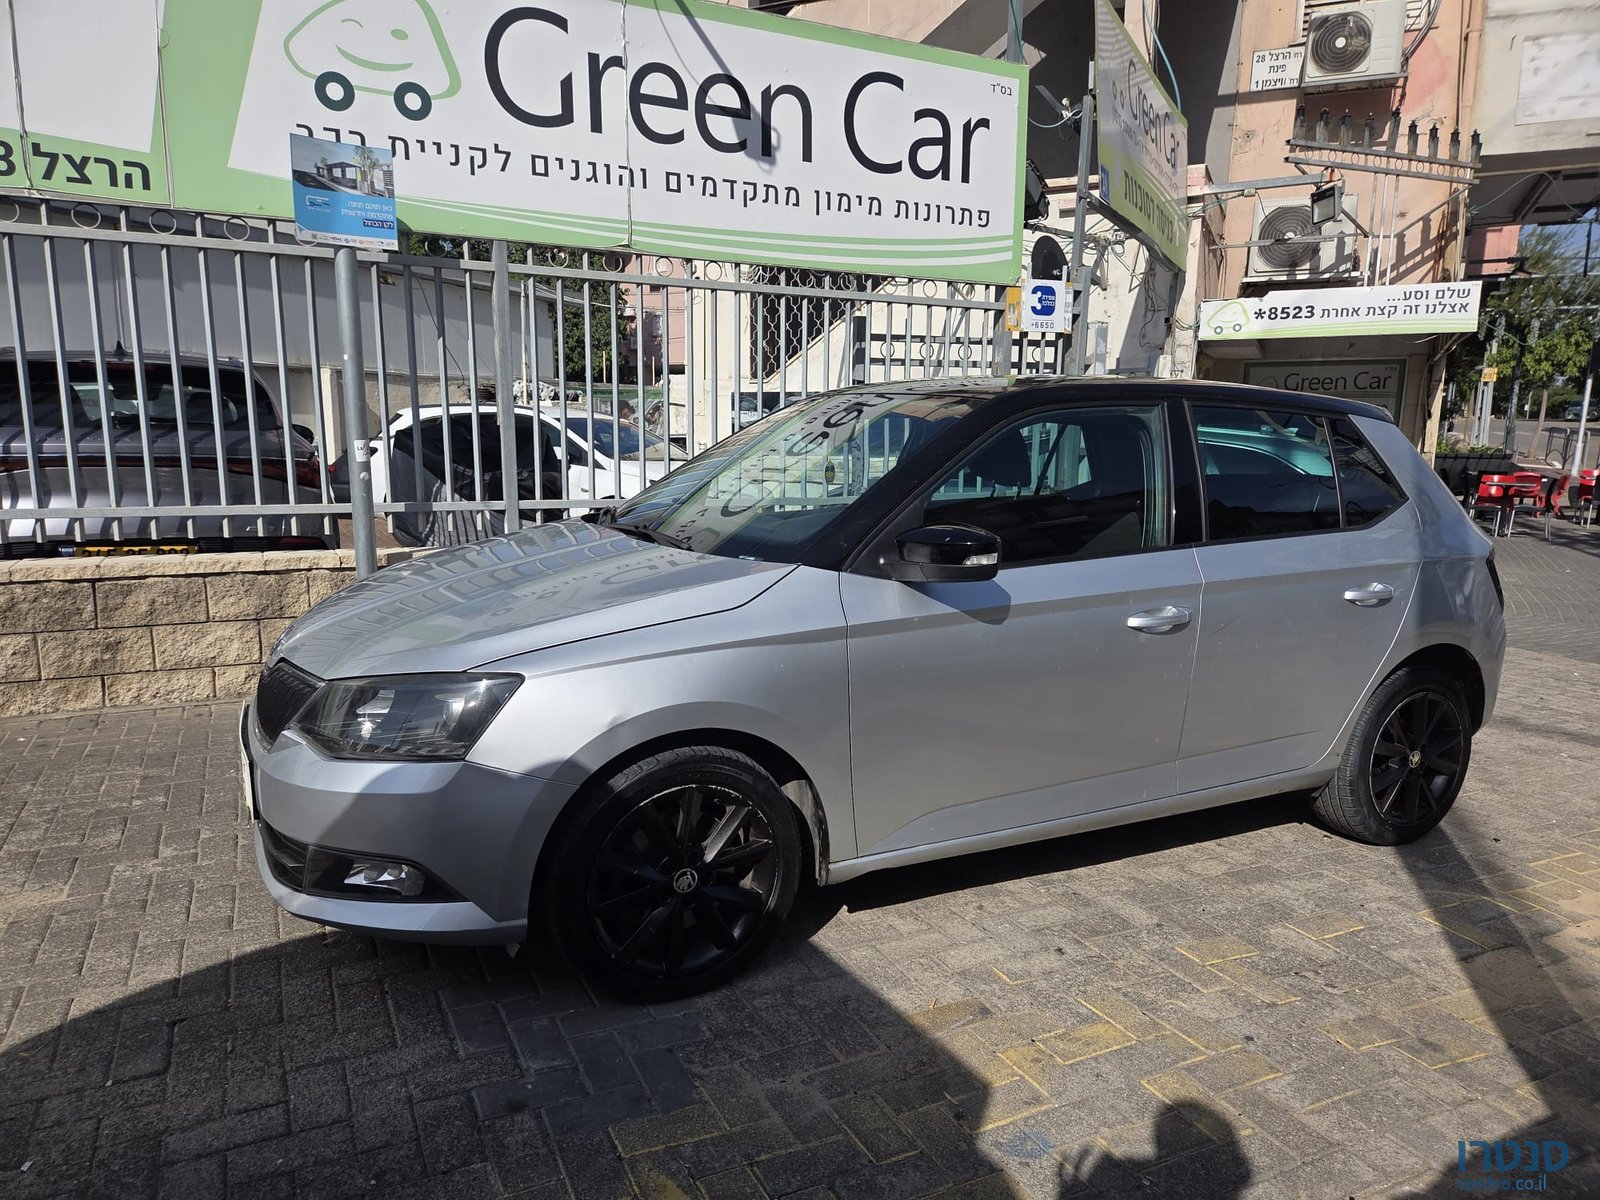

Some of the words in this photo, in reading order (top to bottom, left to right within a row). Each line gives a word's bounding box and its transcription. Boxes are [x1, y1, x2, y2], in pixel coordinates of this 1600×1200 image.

[1255, 54, 1267, 64] 28
[1268, 51, 1292, 62] הרצל
[1268, 64, 1287, 75] פינת
[1255, 80, 1260, 89] 1
[484, 6, 813, 163] Green
[843, 71, 991, 183] Car
[1127, 58, 1162, 154] Green
[1163, 111, 1180, 176] Car
[387, 134, 512, 176] לקניית
[31, 142, 151, 191] הרצל
[530, 154, 648, 190] והוגנים
[665, 170, 800, 208] מתקדמים
[813, 188, 883, 216] מימון
[893, 198, 991, 229] פתרונות
[1386, 290, 1429, 302] וסע...
[1434, 286, 1471, 300] שלם
[1320, 306, 1361, 319] אחרת
[1365, 304, 1398, 319] קצת
[1403, 303, 1420, 315] זה
[1425, 301, 1470, 314] אצלנו
[1283, 372, 1348, 392] Green
[1353, 370, 1393, 391] Car
